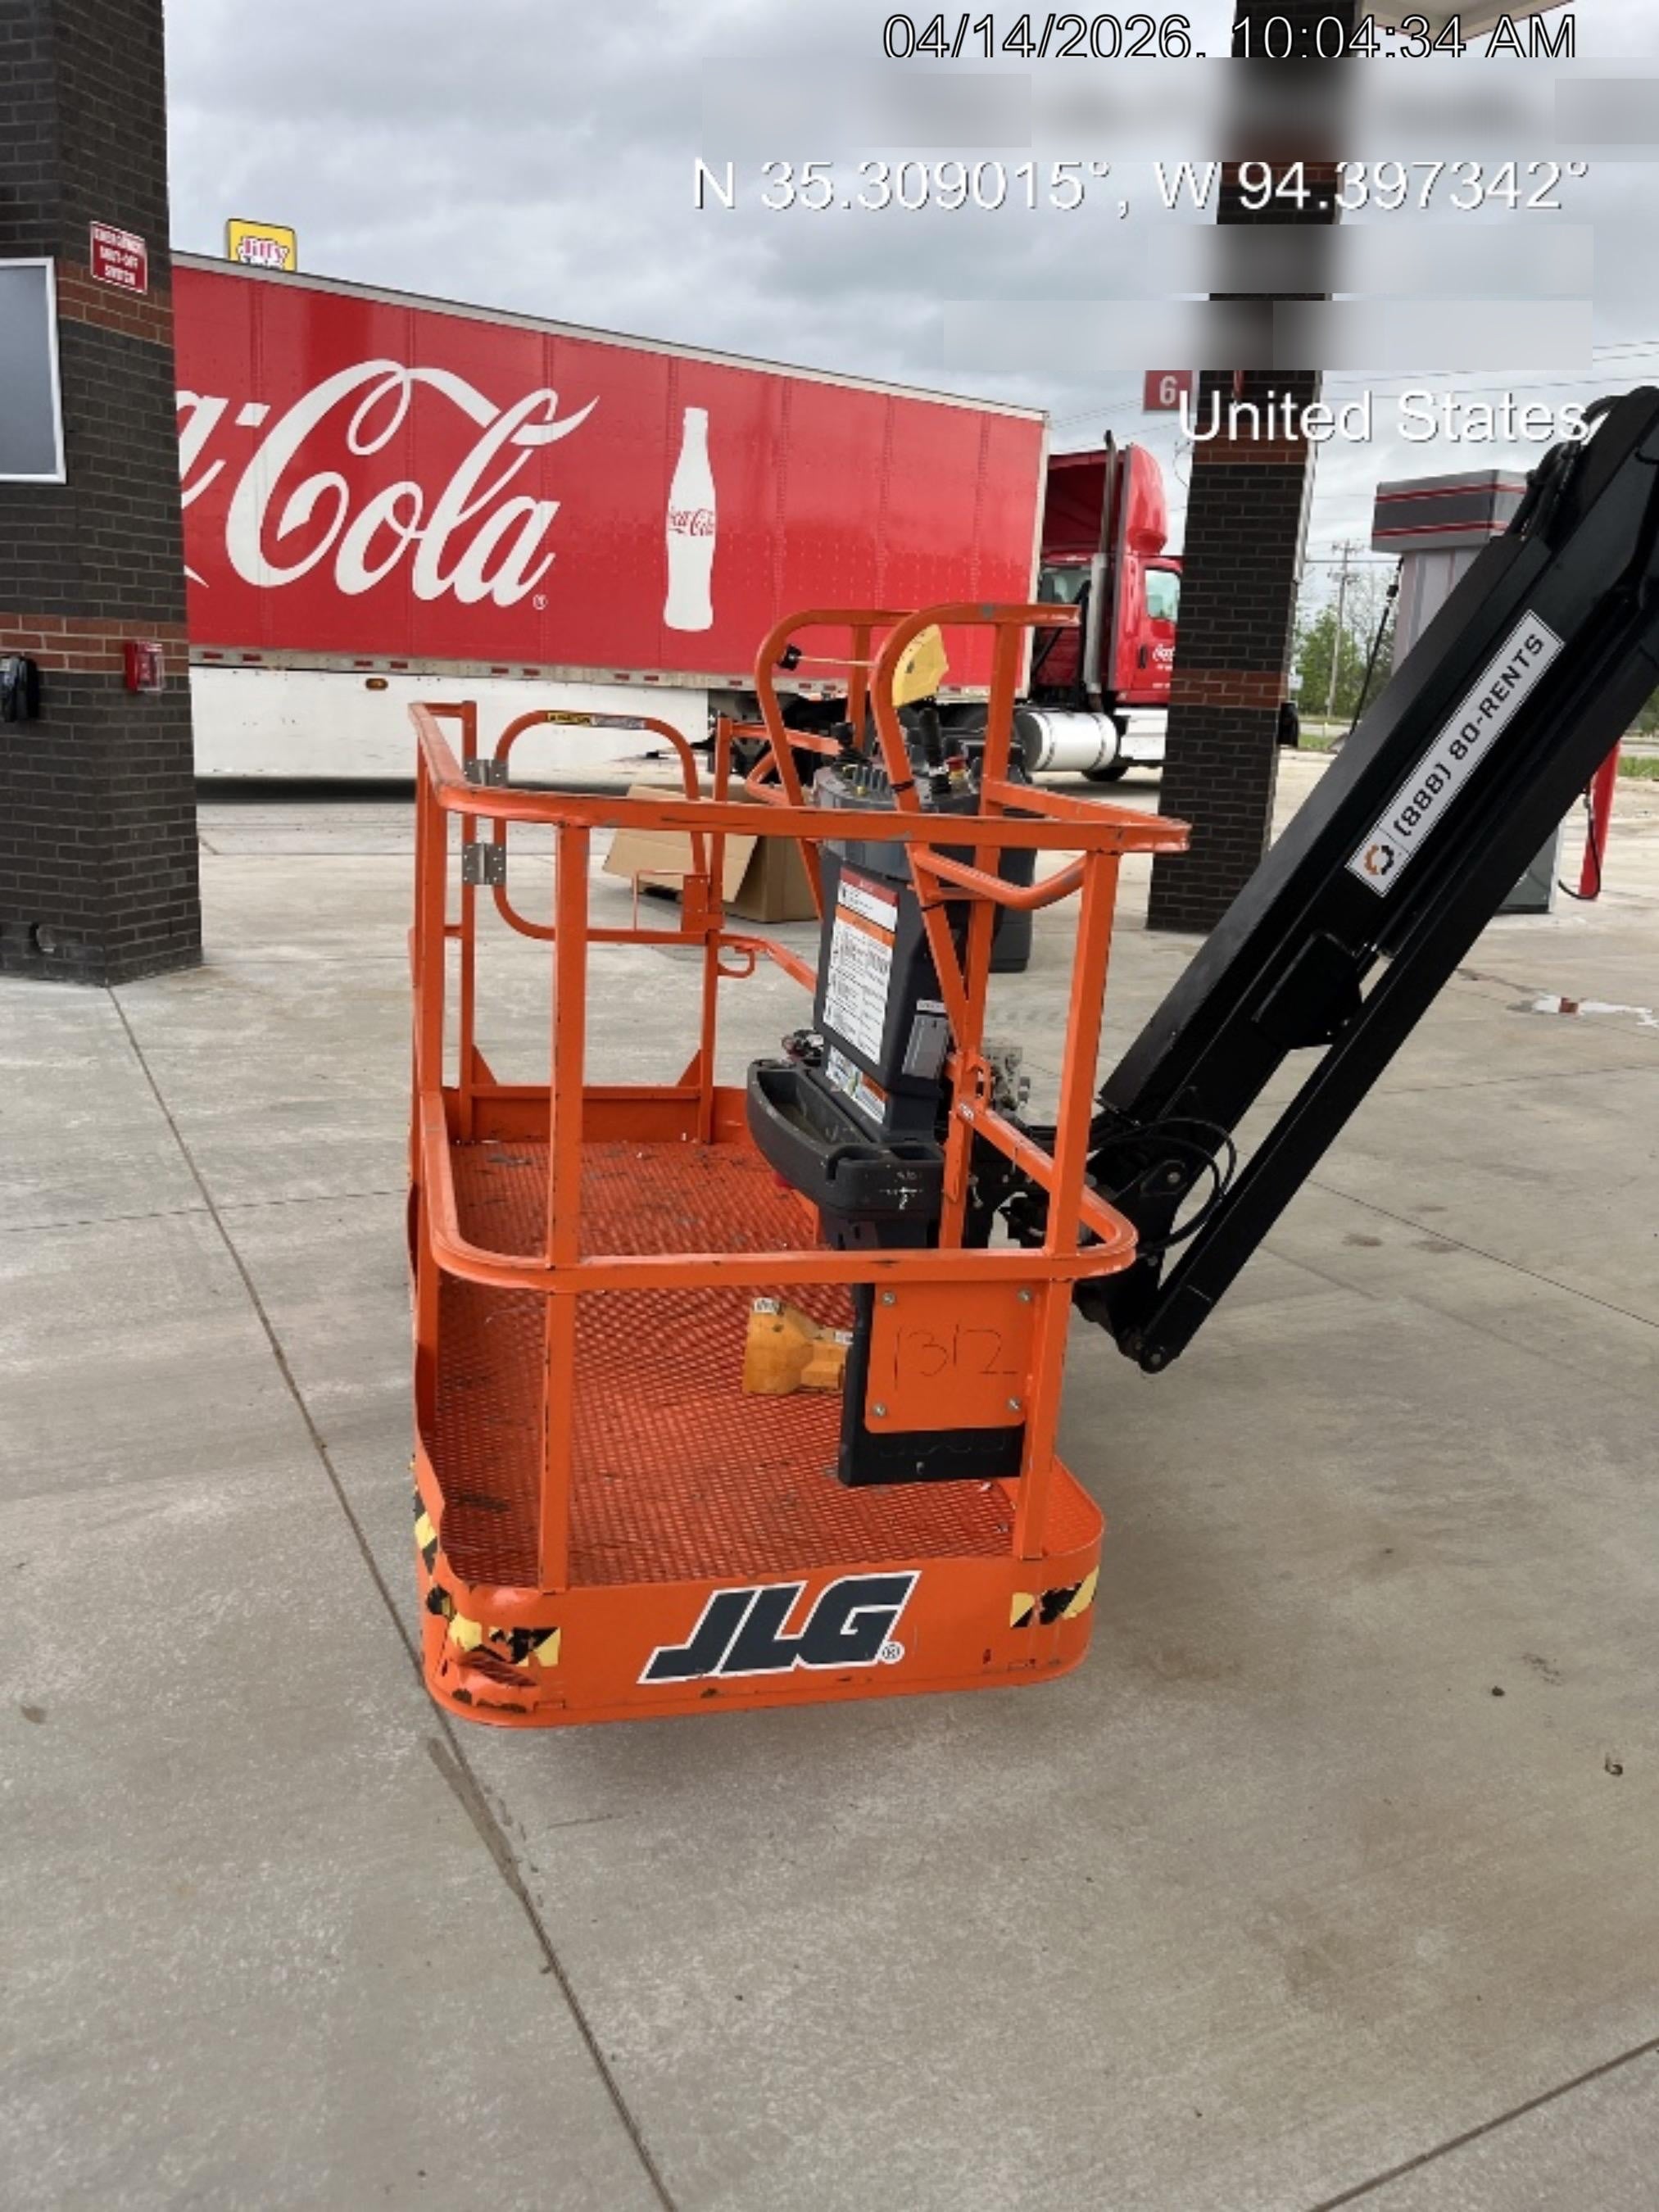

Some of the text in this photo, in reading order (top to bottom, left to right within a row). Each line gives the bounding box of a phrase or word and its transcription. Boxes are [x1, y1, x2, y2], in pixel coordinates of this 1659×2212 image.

[1159, 374, 1178, 406] 6
[175, 358, 601, 608] a-Cola
[1394, 633, 1544, 836] (888) 80-RENTS
[637, 1571, 922, 1684] JLG
